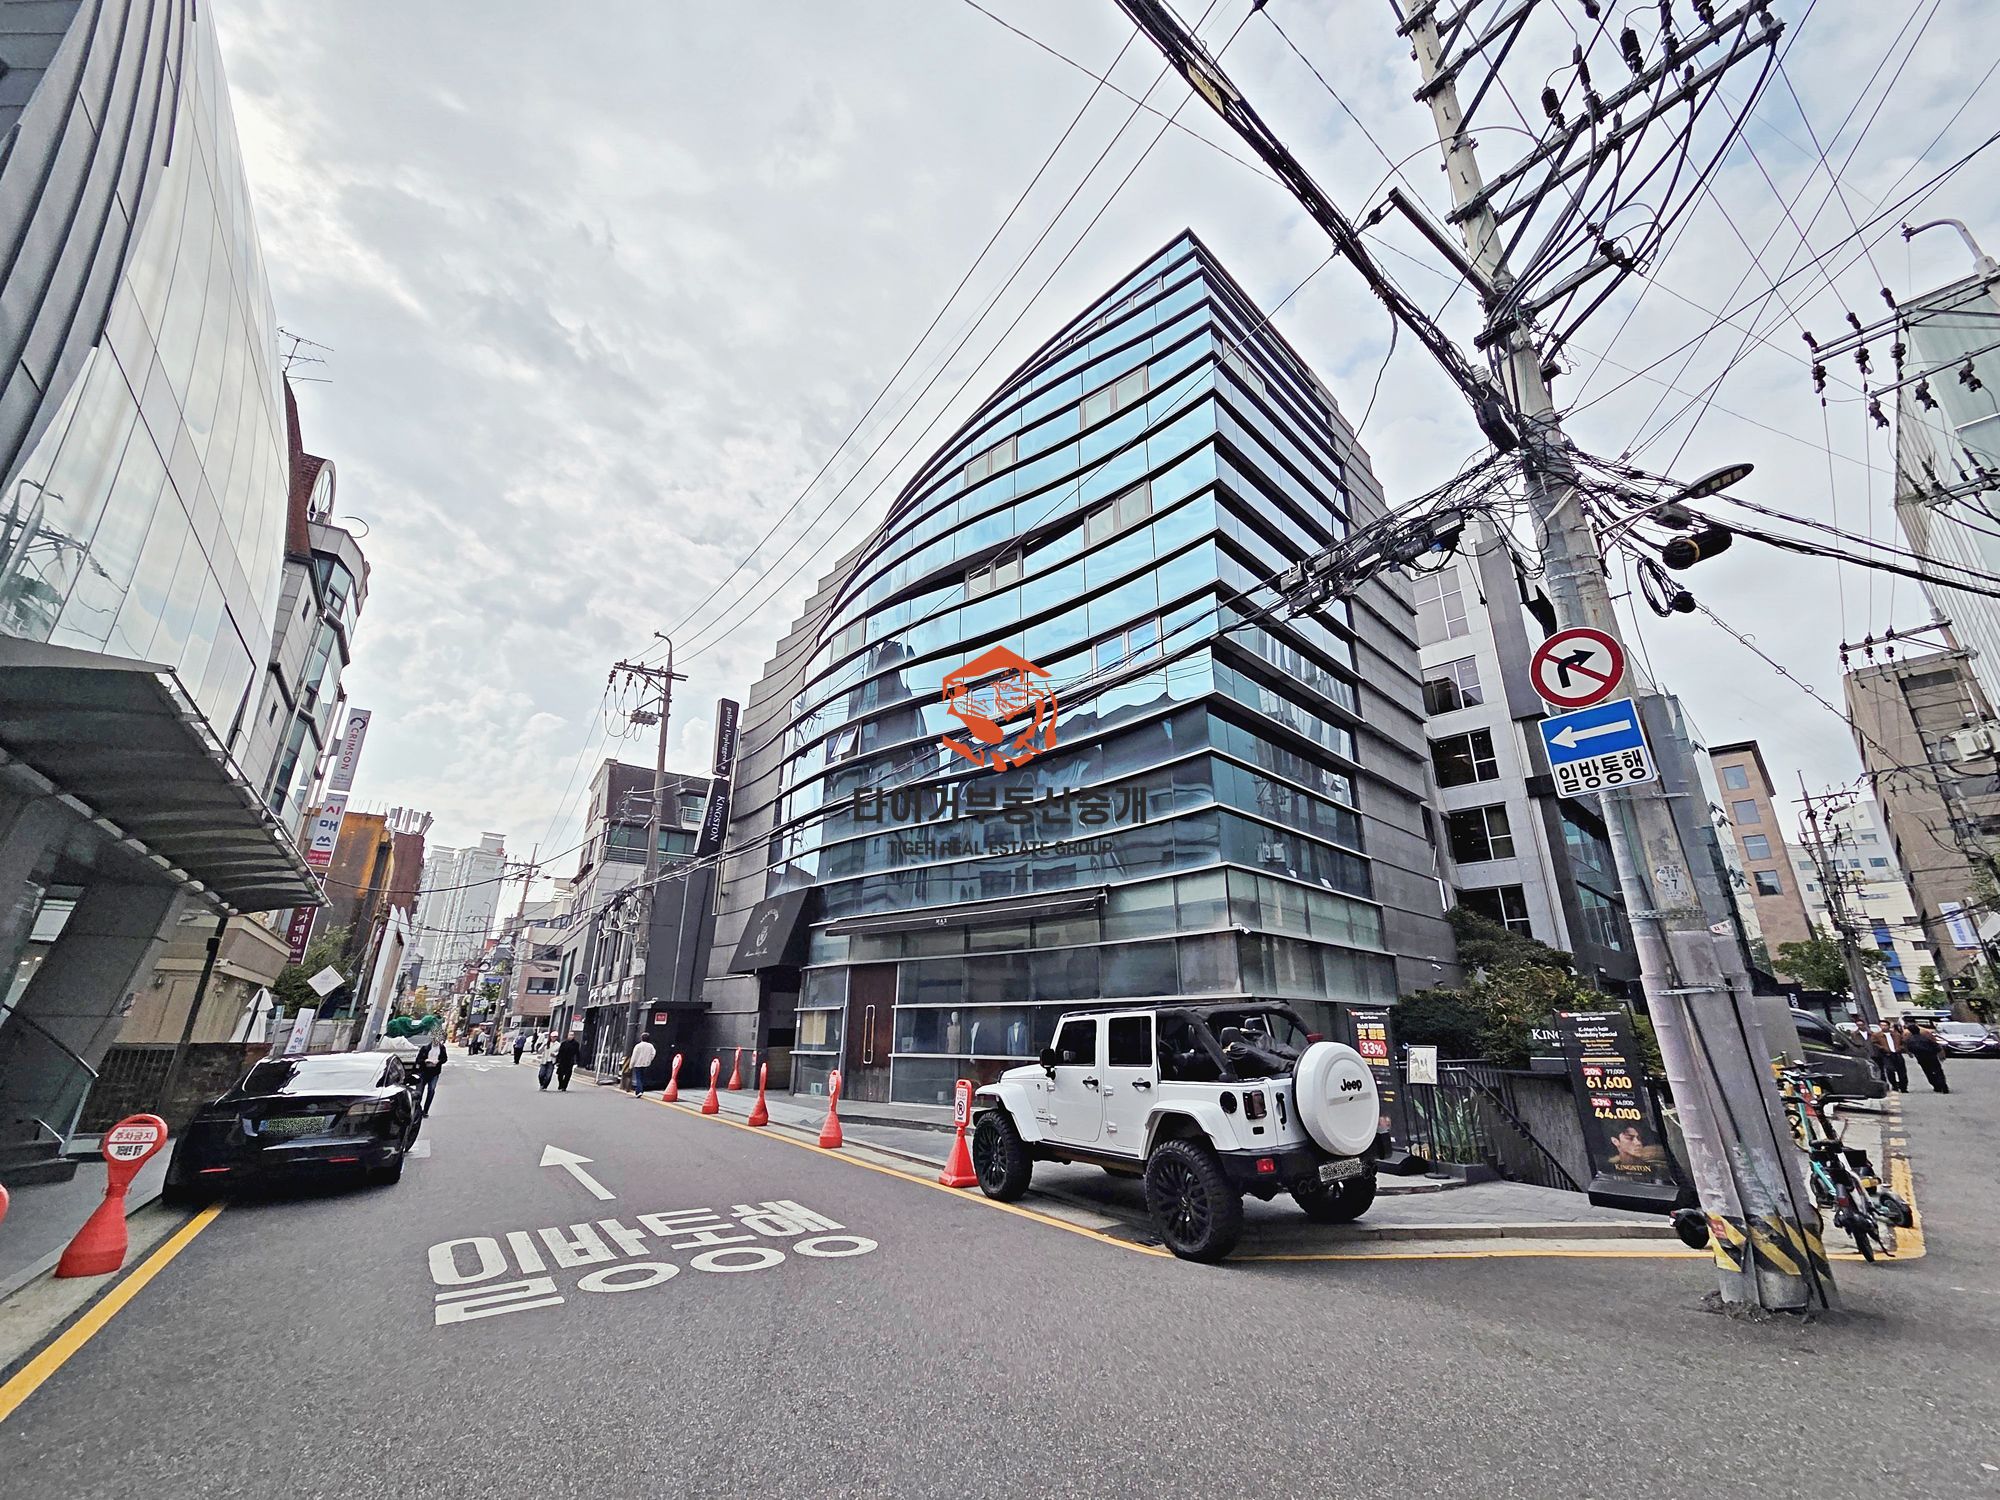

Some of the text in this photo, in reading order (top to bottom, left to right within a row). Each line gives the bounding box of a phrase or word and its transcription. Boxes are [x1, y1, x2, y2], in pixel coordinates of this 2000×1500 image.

[341, 727, 359, 770] CRIMSON
[721, 706, 733, 762] gallery Unplugged
[1558, 749, 1646, 793] 일방통행
[315, 805, 341, 847] 시매쓰
[710, 795, 726, 842] KINGSTON
[1362, 1042, 1383, 1055] 33%
[1341, 1079, 1362, 1091] Jeep
[1586, 1077, 1632, 1090] 61,600
[115, 1132, 153, 1140] 주차금지
[1614, 1163, 1652, 1173] KINGSTON
[427, 1199, 879, 1326] 일방통행
